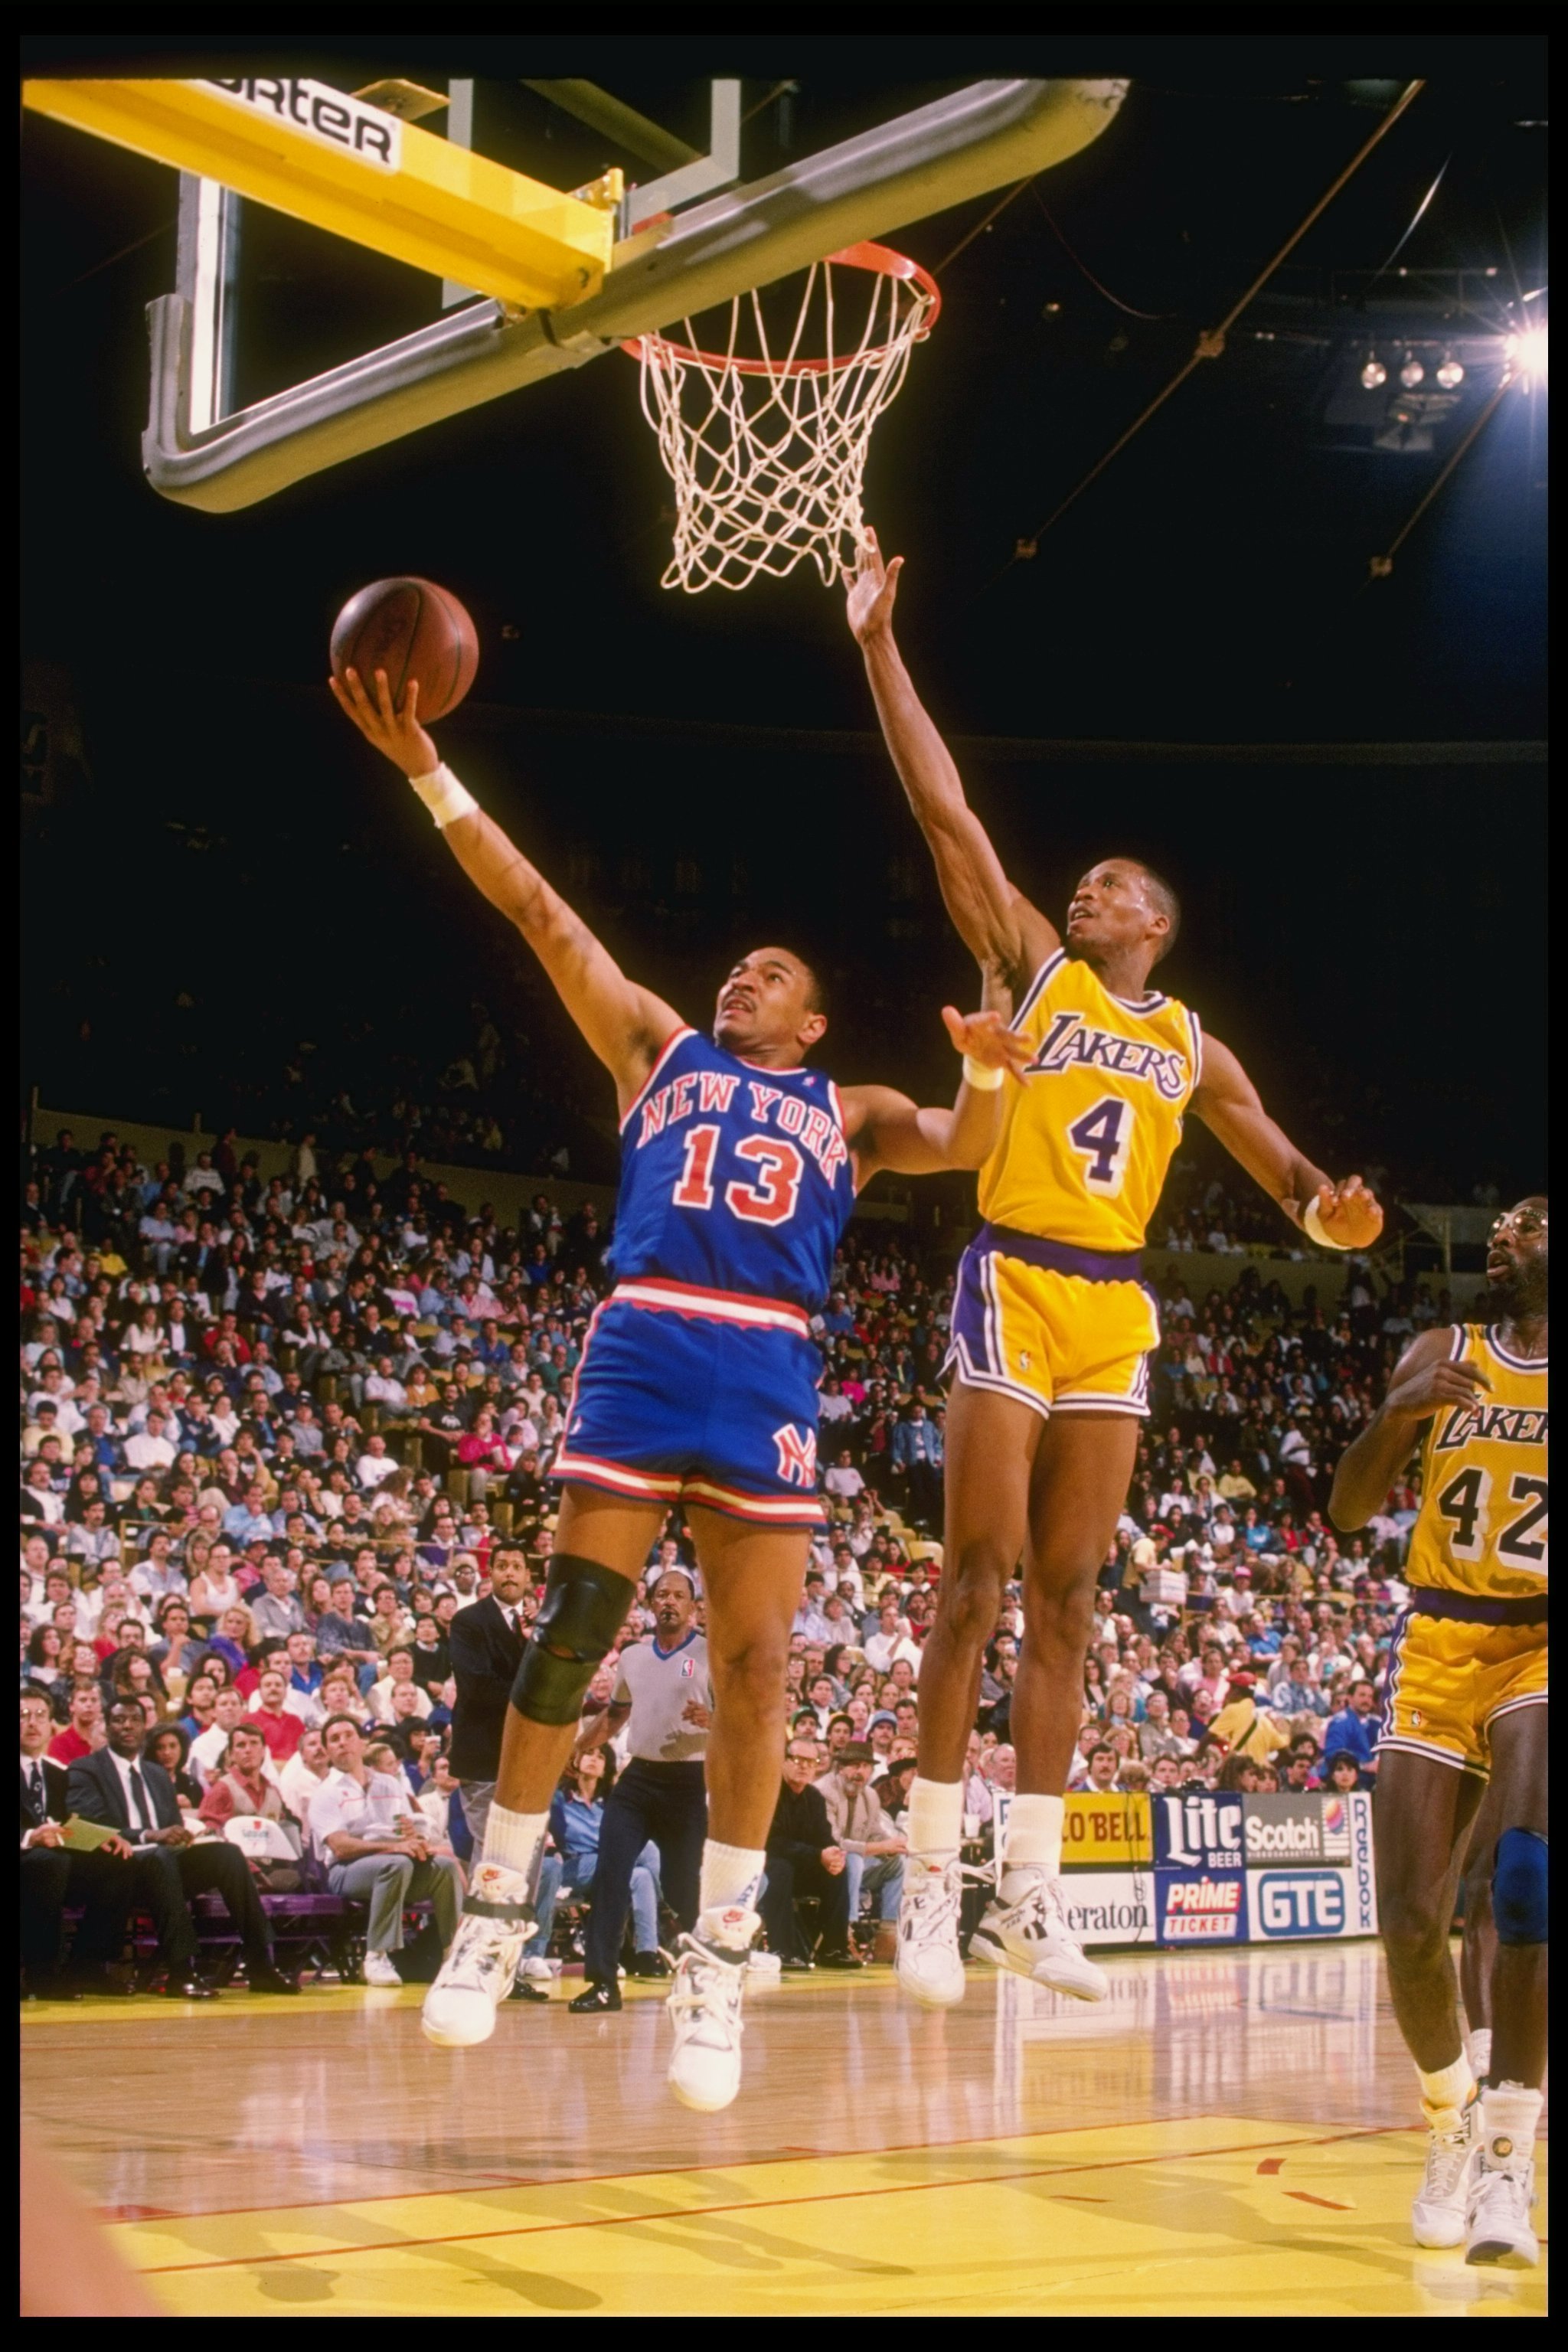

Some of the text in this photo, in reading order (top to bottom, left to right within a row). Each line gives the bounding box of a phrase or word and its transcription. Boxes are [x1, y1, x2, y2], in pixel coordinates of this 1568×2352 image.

[1024, 1012, 1187, 1101] LAKERS
[637, 1072, 848, 1190] NEW YORK
[1067, 1096, 1132, 1191] 4
[673, 1123, 805, 1227] 13
[1437, 1465, 1548, 1565] 42
[1089, 1811, 1146, 1841] BELL
[1163, 1795, 1242, 1867] Lite
[1207, 1851, 1242, 1868] BEER
[1246, 1815, 1319, 1851] Scotch
[1354, 1798, 1370, 1929] Reebok
[1169, 1916, 1230, 1933] TICKET
[1263, 1879, 1341, 1929] GTE
